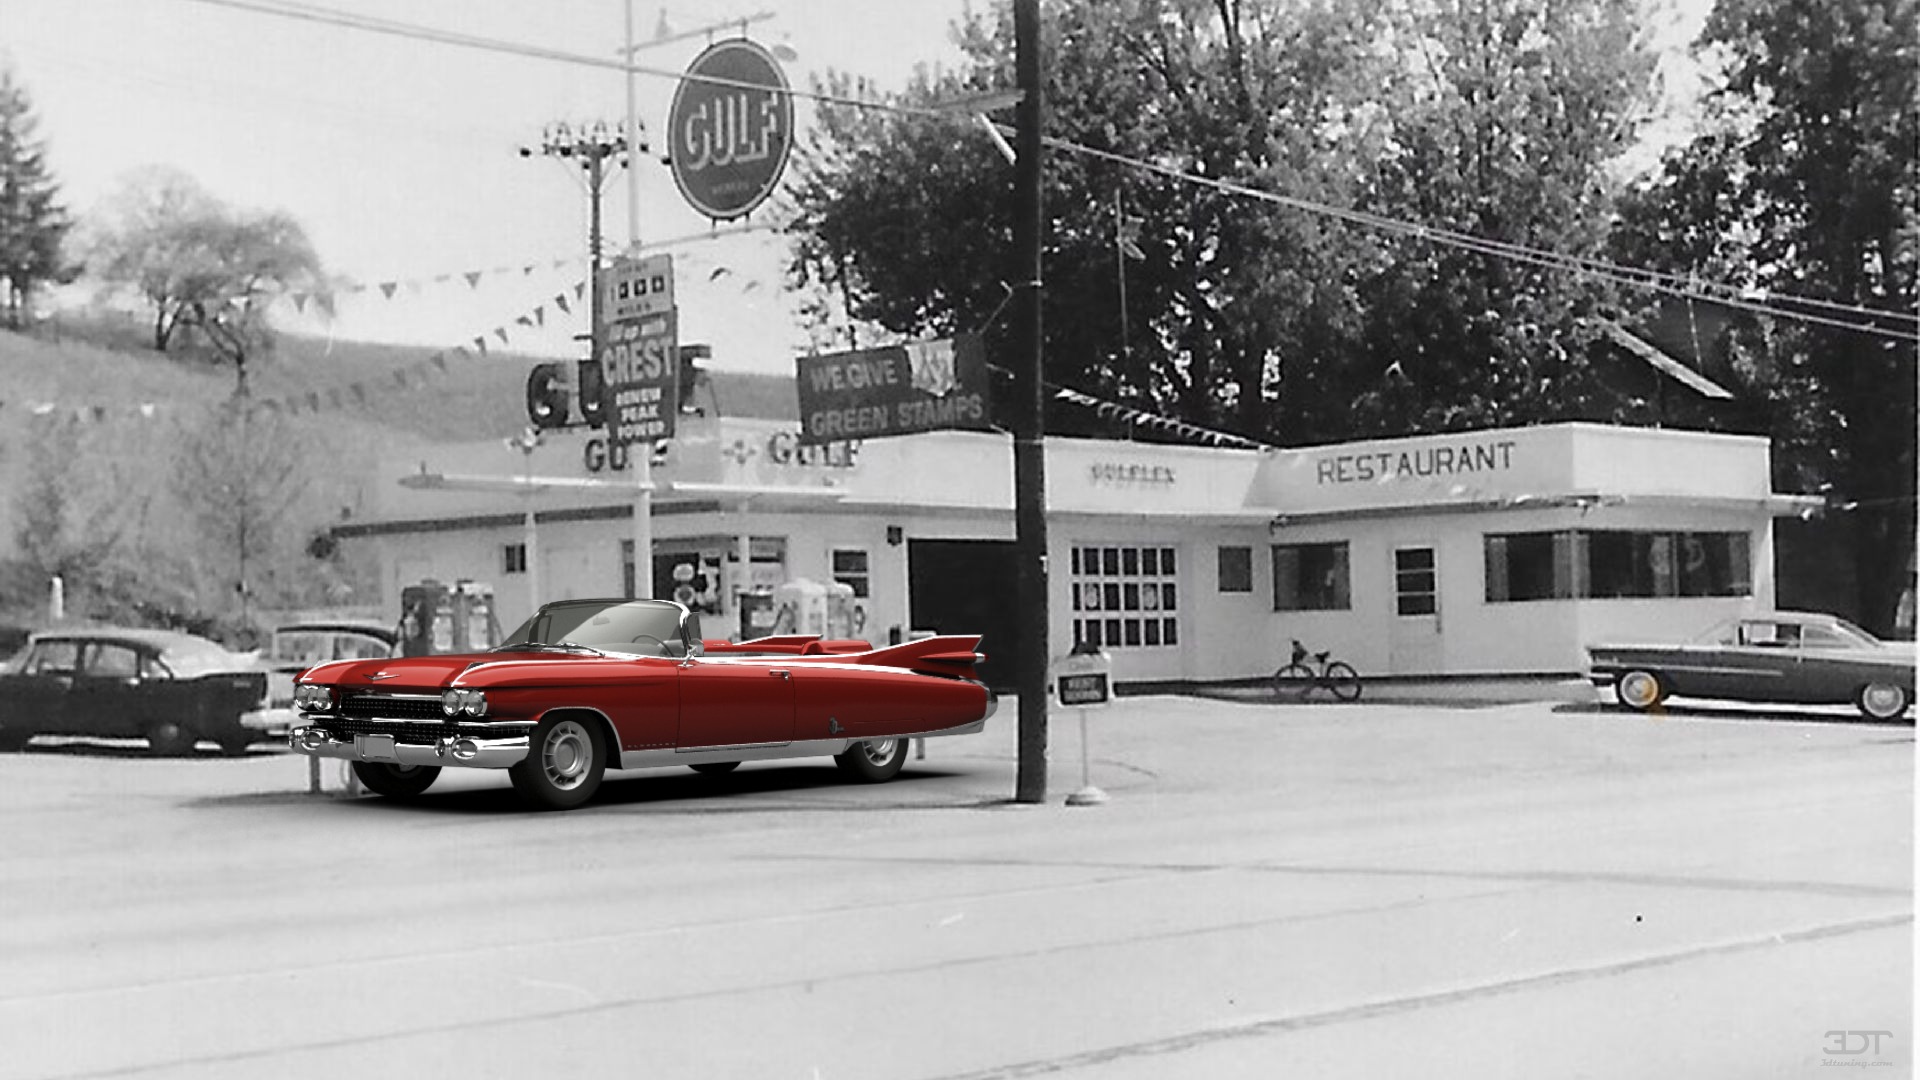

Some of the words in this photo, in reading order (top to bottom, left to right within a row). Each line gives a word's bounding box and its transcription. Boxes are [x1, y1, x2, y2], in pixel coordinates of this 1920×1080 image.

[686, 91, 777, 170] GULF
[602, 338, 674, 387] CREST
[810, 365, 845, 392] WE
[847, 359, 897, 387] GIVE
[617, 420, 665, 438] POWER
[621, 404, 659, 422] PEAK
[811, 405, 888, 437] GREEN
[899, 393, 983, 427] STAMPS
[1317, 441, 1516, 485] RESTAURANT
